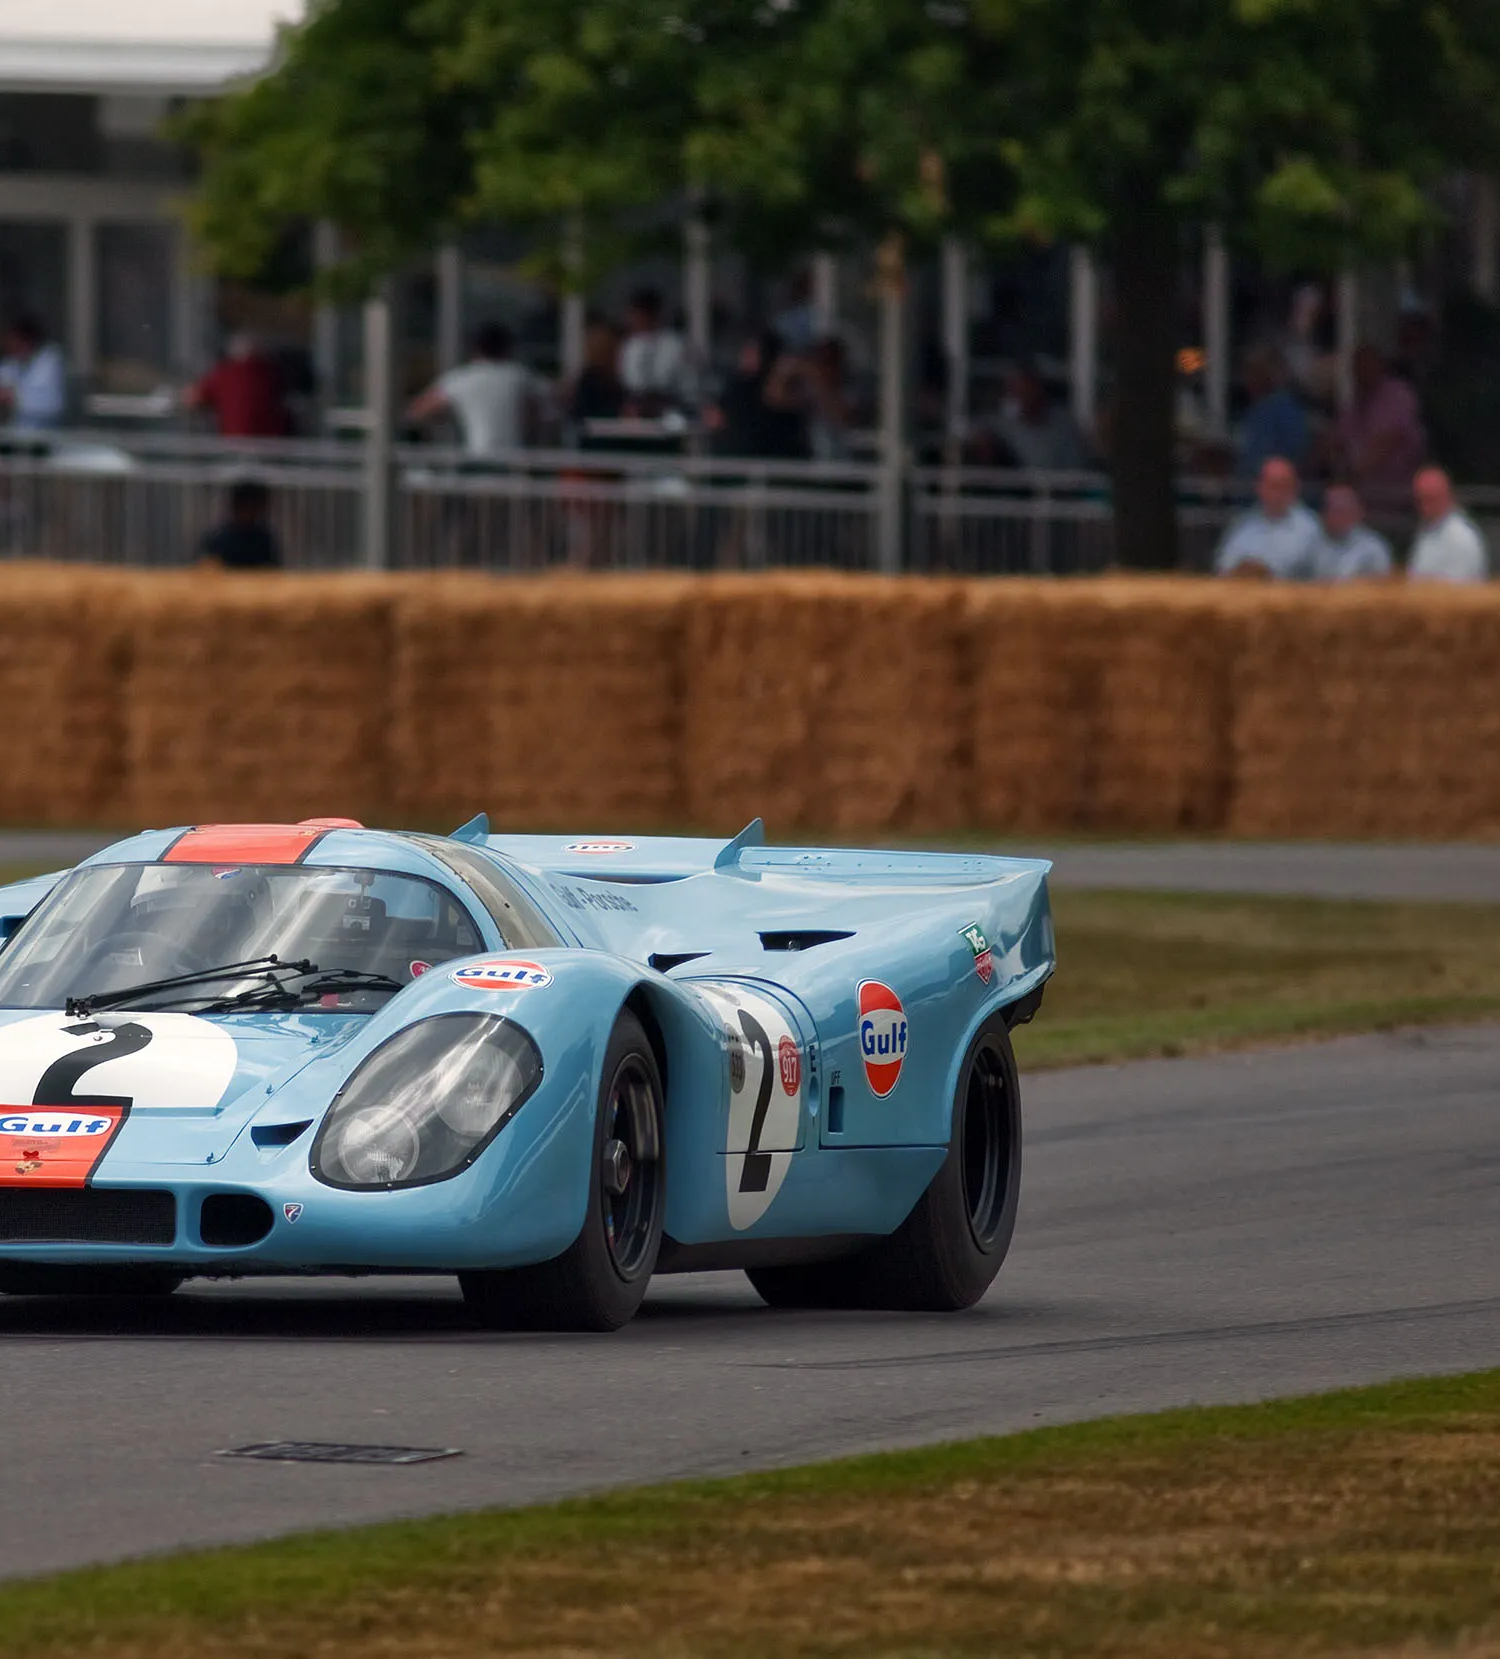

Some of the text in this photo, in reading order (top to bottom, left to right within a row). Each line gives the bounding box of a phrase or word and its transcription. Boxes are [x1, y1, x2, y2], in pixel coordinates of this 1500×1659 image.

[455, 966, 548, 984] Gulf
[861, 1020, 908, 1056] Gulf
[32, 1022, 153, 1107] 2
[782, 1056, 797, 1083] 917
[737, 1009, 774, 1193] 2
